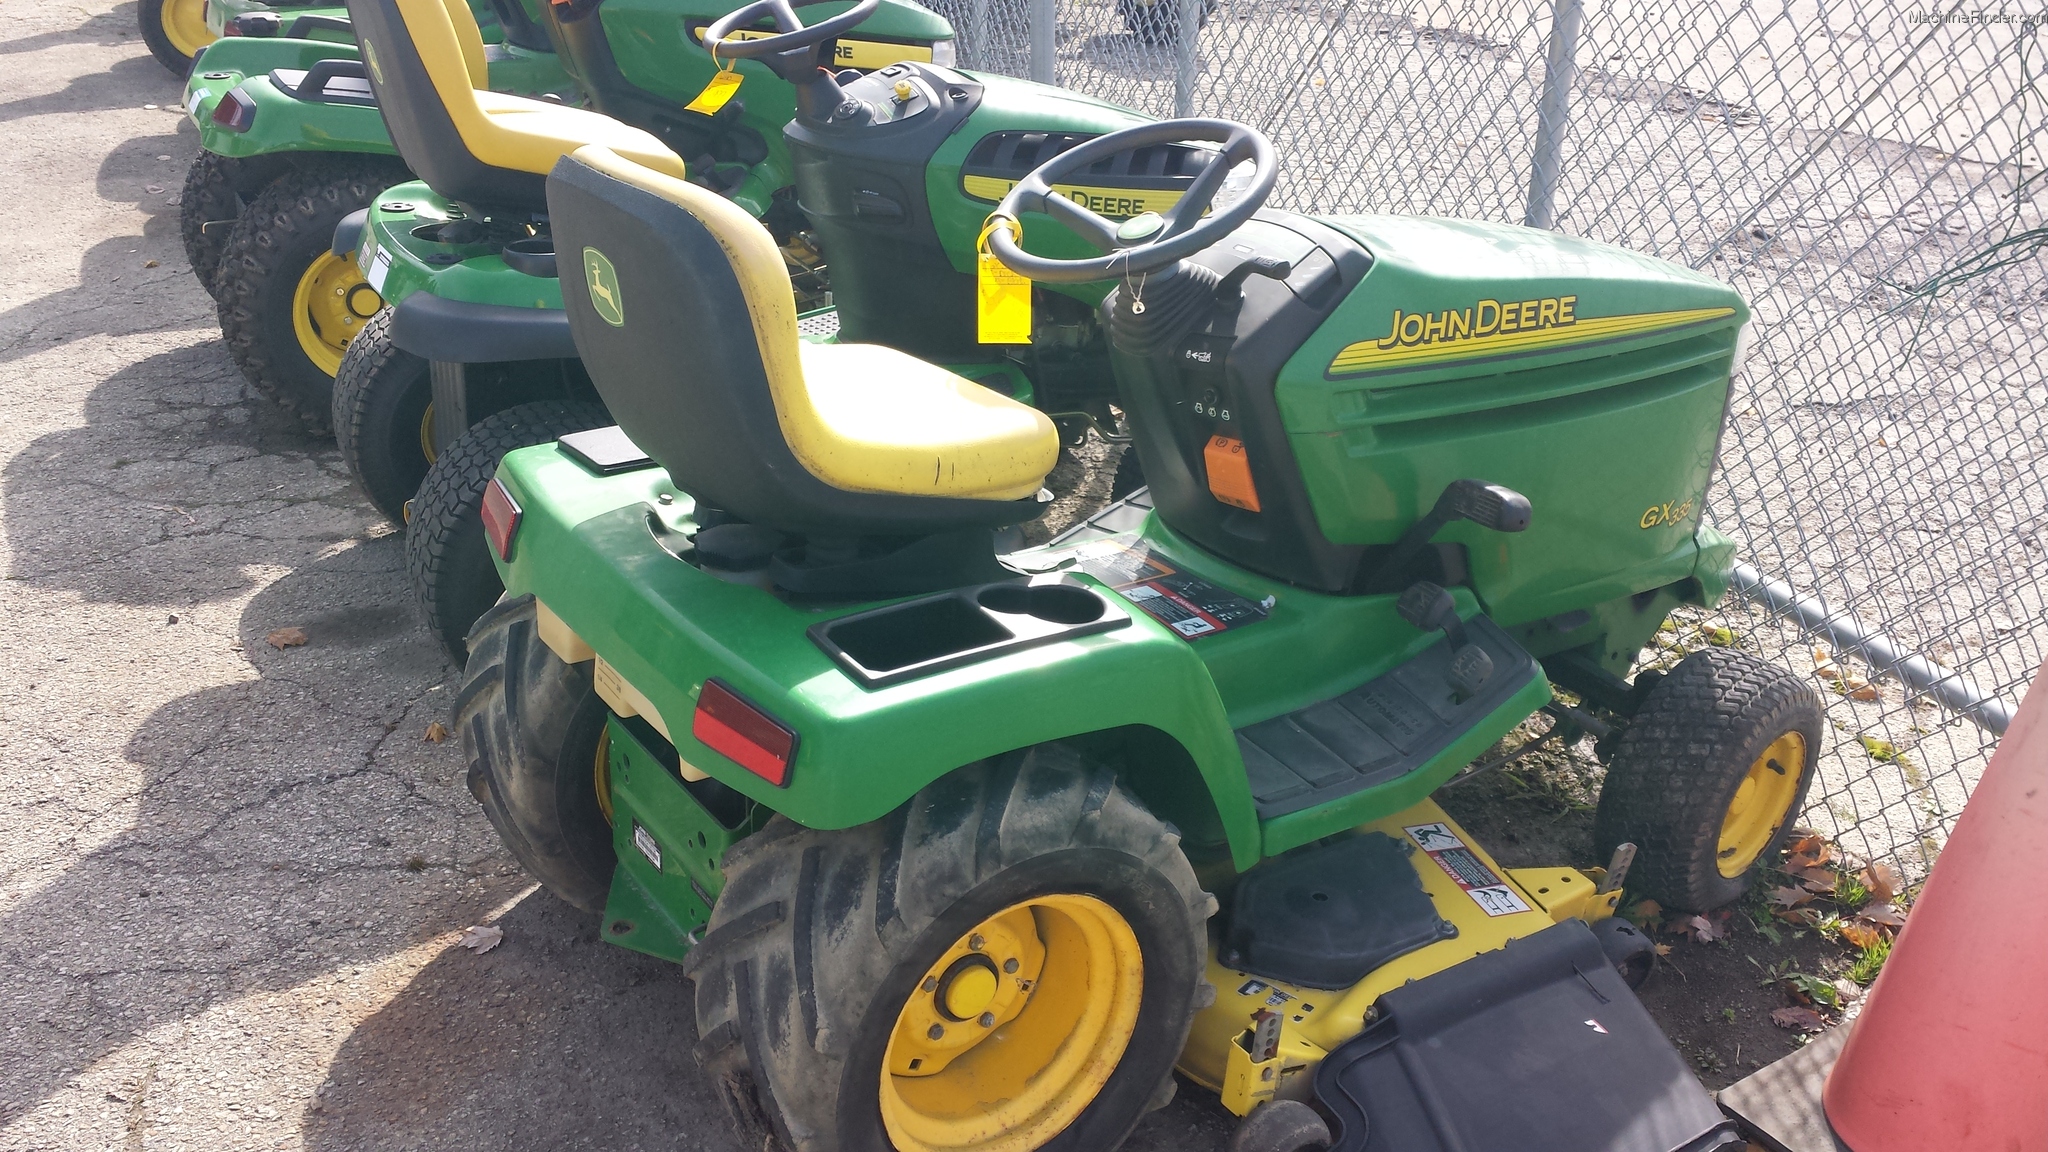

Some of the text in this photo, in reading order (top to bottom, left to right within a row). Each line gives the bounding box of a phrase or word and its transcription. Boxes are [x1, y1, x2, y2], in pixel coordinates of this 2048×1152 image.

[1071, 190, 1146, 215] DEERE
[1377, 294, 1578, 350] JOHN DEERE
[1175, 598, 1202, 614] DANGER
[1433, 855, 1460, 880] DANGER
